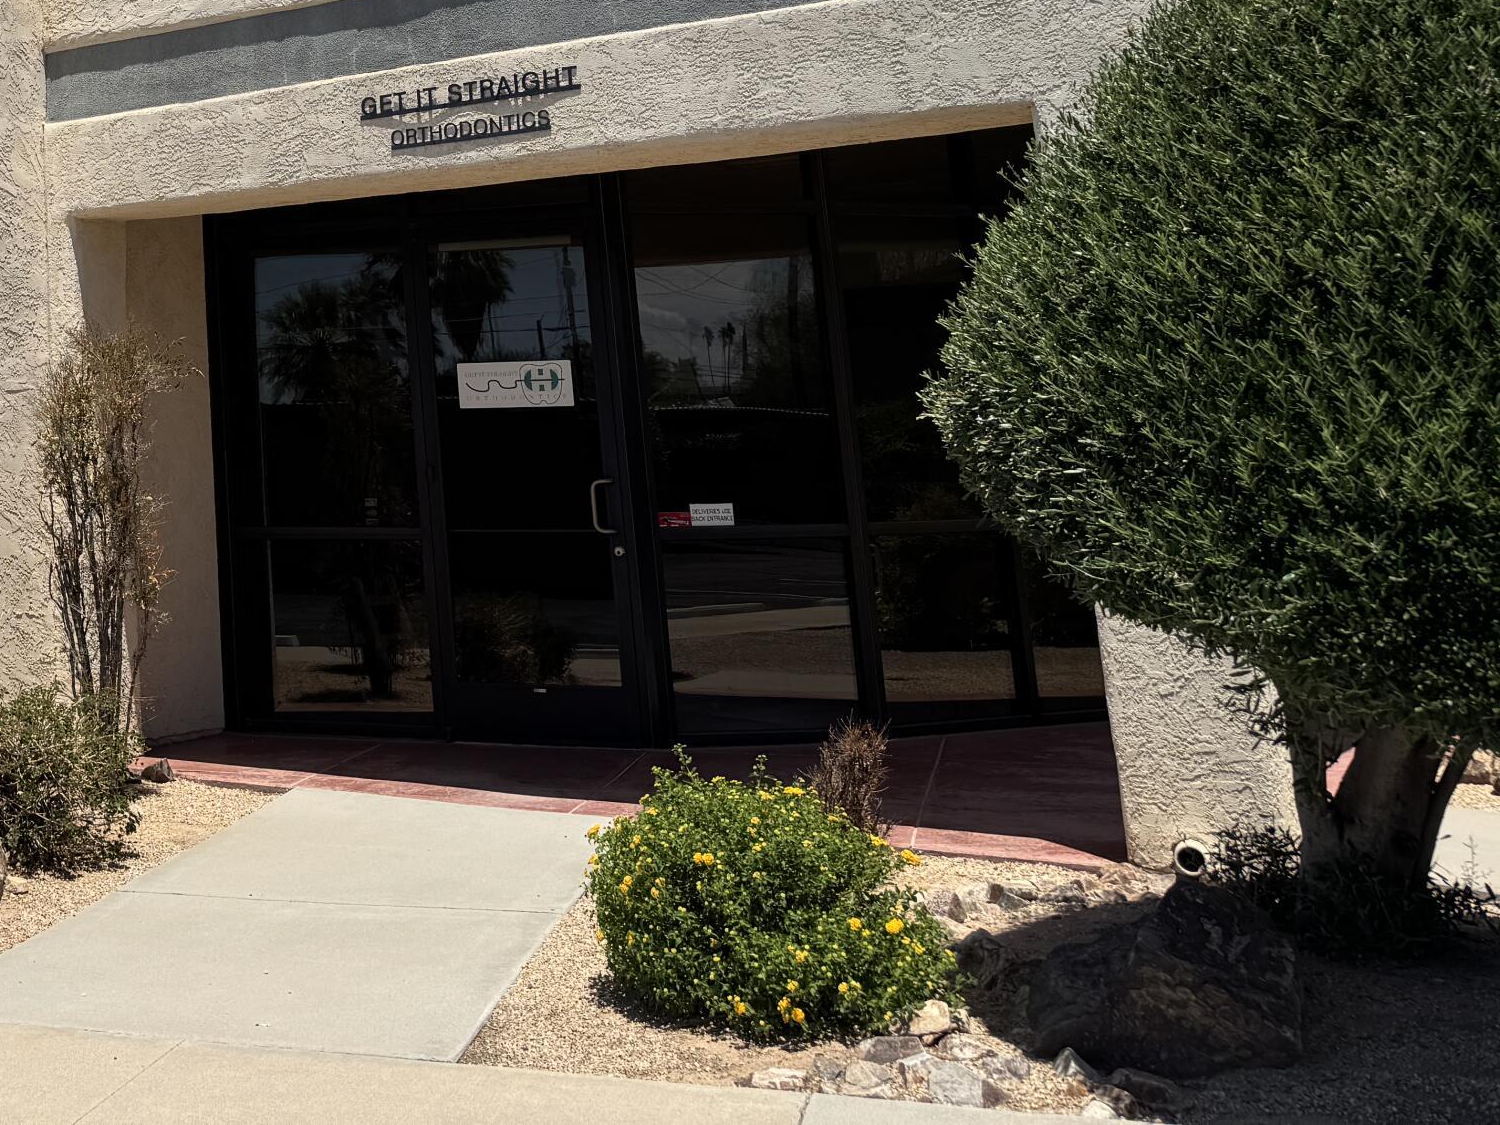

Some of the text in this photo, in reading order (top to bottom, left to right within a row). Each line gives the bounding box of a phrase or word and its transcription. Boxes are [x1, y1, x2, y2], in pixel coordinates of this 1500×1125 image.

[361, 65, 578, 116] GET IT STRAIGHT
[391, 109, 551, 146] ORTHODONTICS
